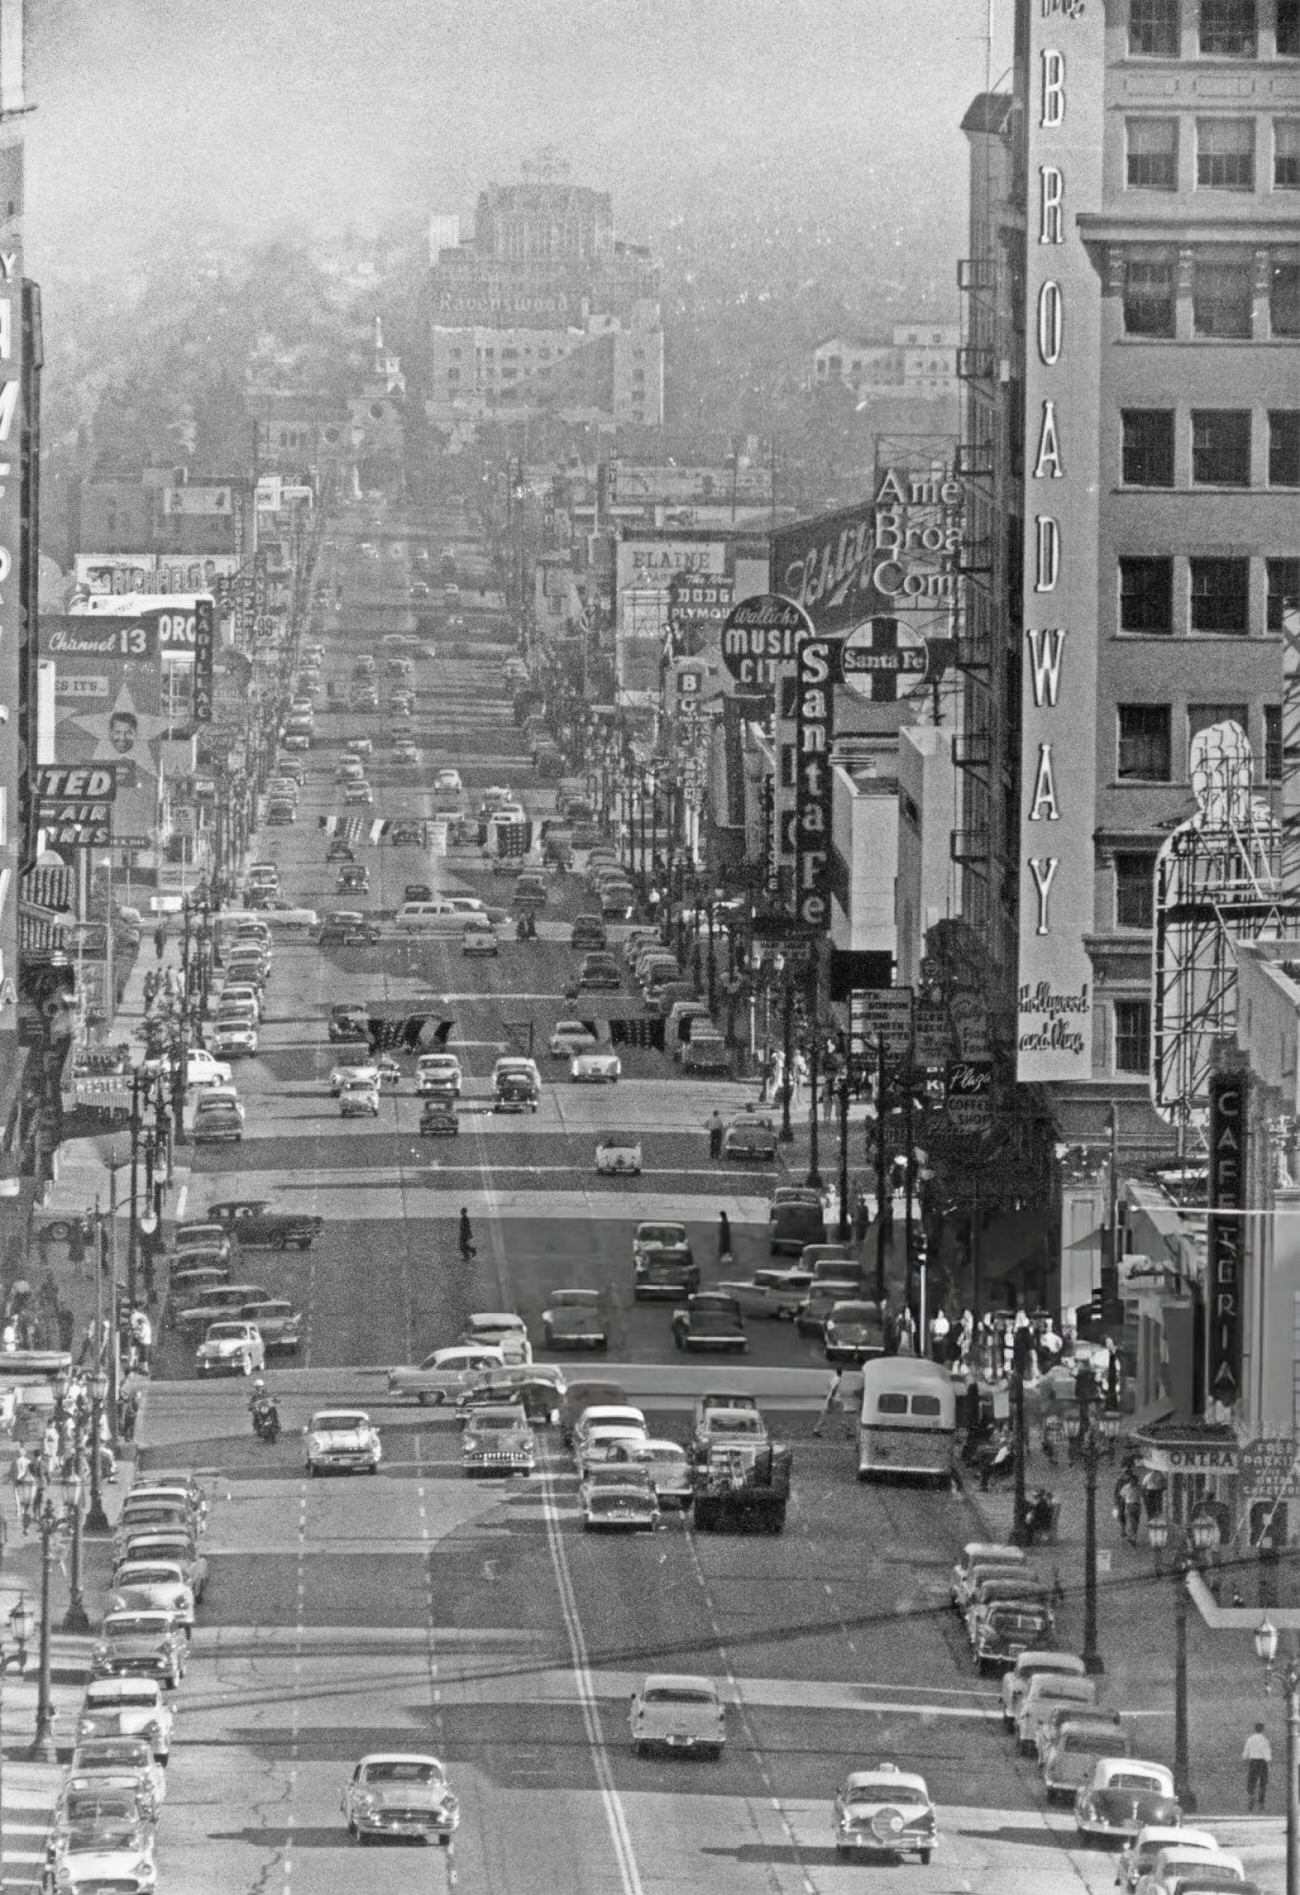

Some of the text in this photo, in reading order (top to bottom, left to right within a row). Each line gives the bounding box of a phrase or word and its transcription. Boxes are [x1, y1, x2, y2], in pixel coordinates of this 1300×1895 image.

[1026, 48, 1067, 936] BROADWAY
[632, 551, 710, 569] ELAINE
[49, 628, 147, 653] Channel 13
[197, 604, 210, 719] CADILLAC
[843, 649, 925, 669] Santa Fe
[802, 643, 830, 924] Santa Fe
[59, 805, 107, 821] AIR
[868, 1001, 909, 1010] GORDON
[1019, 981, 1090, 1021] Hollywood
[1019, 1022, 1050, 1052] and
[950, 1063, 991, 1093] Plaza
[1213, 1090, 1240, 1386] CAFETERIA
[1169, 1451, 1234, 1467] ONTRA
